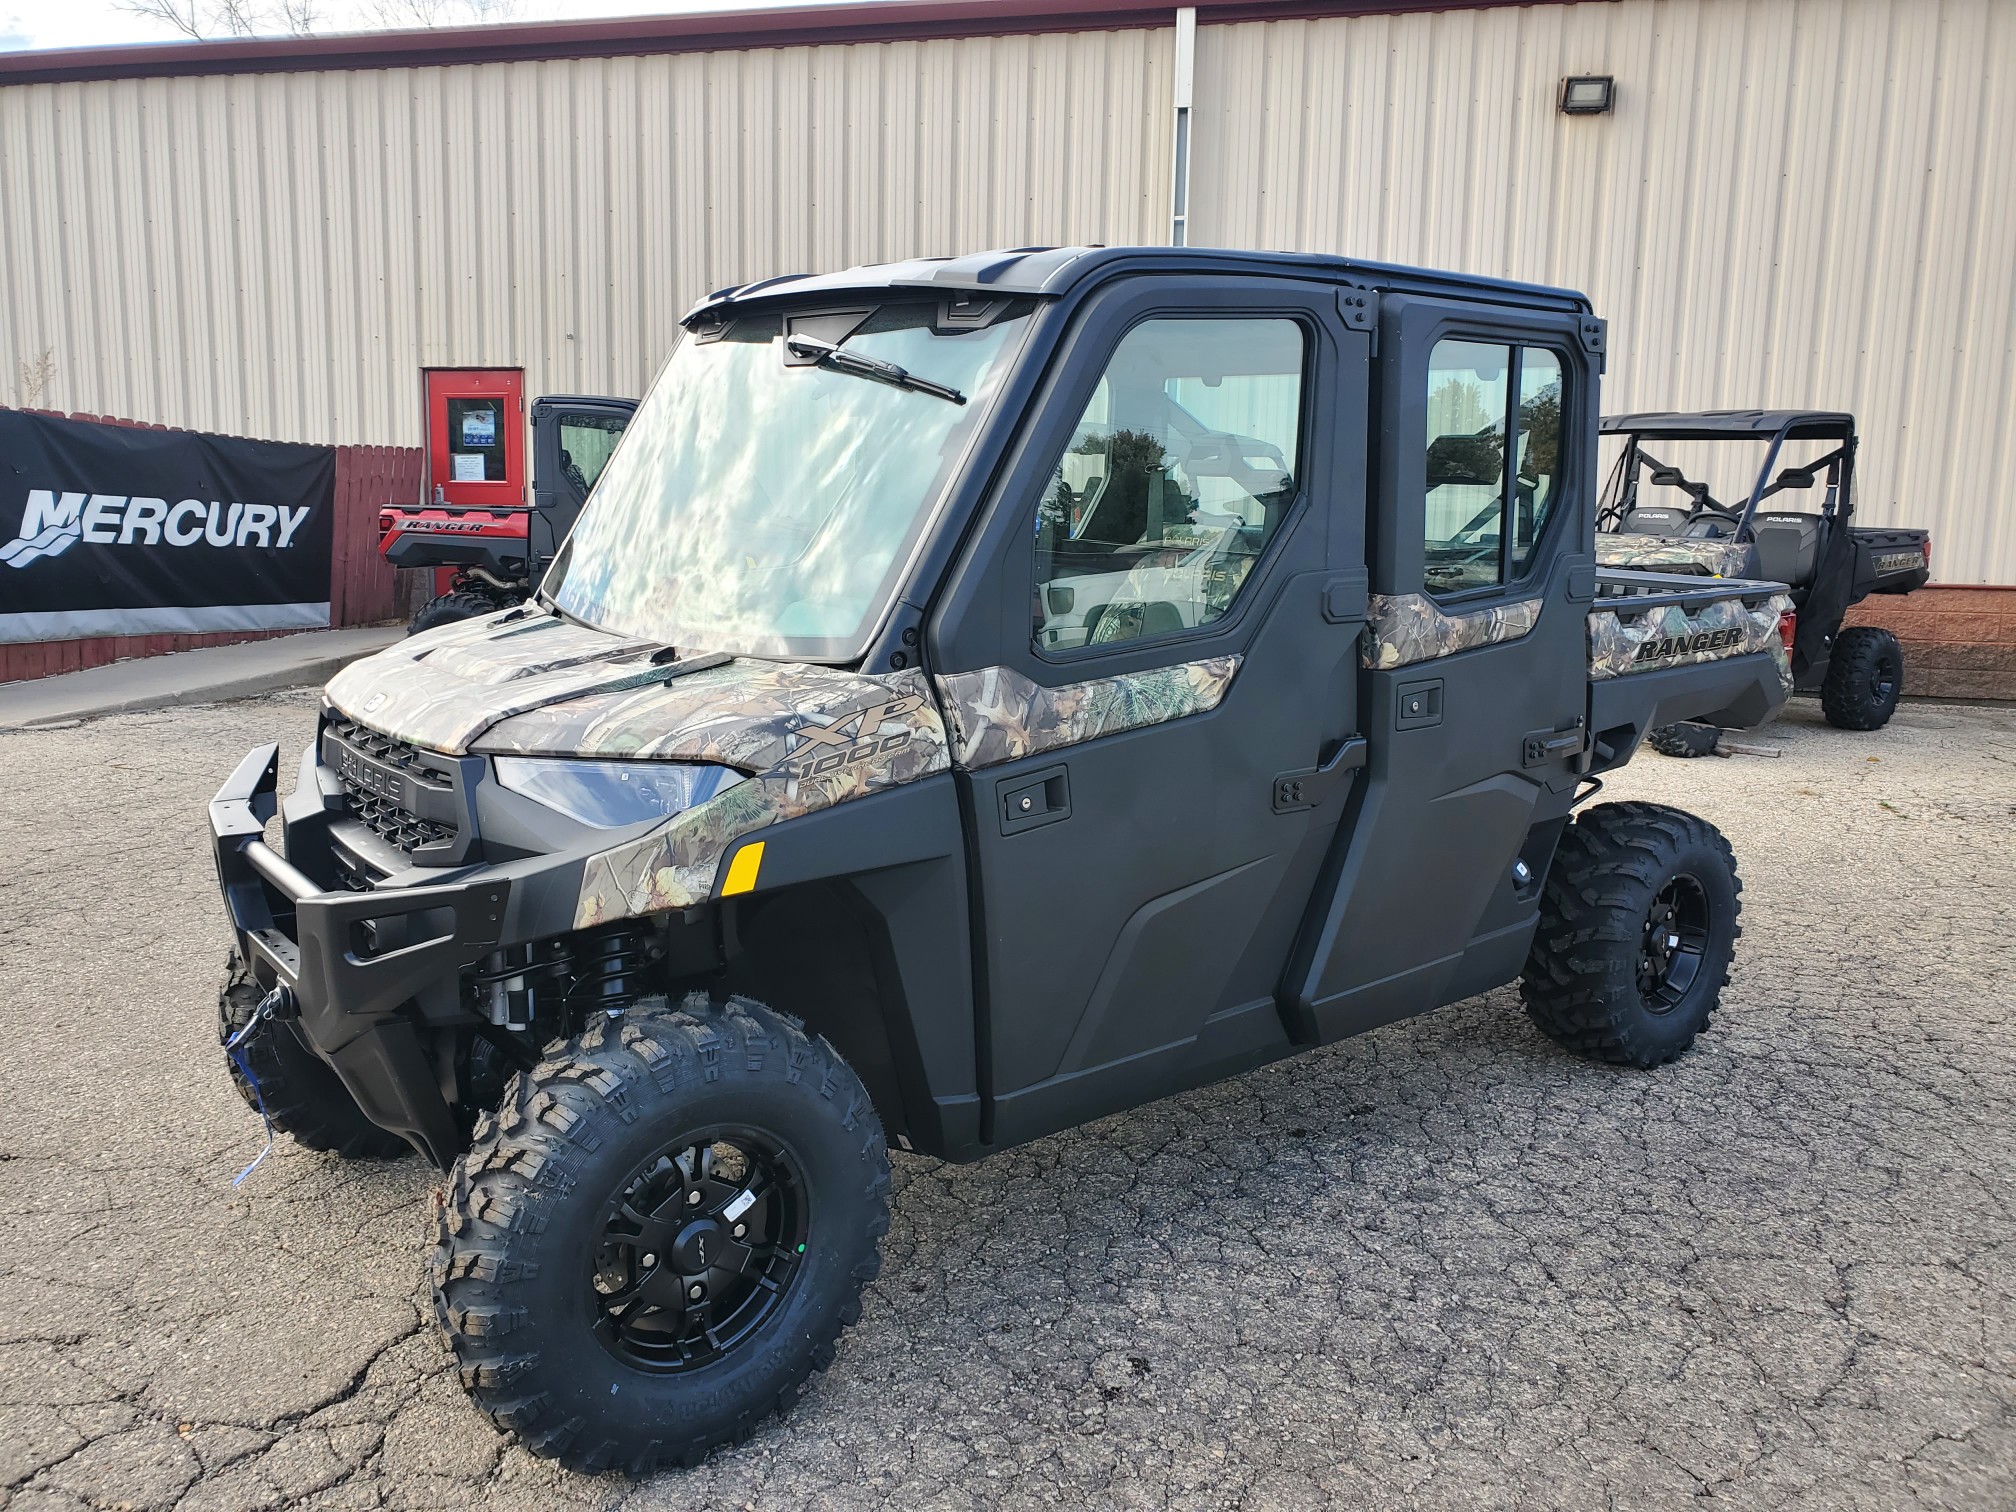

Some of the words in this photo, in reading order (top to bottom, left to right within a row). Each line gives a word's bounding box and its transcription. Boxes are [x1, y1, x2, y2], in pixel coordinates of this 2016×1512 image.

[18, 489, 310, 548] MERCURY
[406, 521, 483, 532] RANGER
[1877, 557, 1920, 570] RANGER
[1634, 627, 1744, 663] RANGER
[771, 694, 927, 768] XP
[799, 730, 912, 781] 1000
[341, 747, 401, 801] POLARIS
